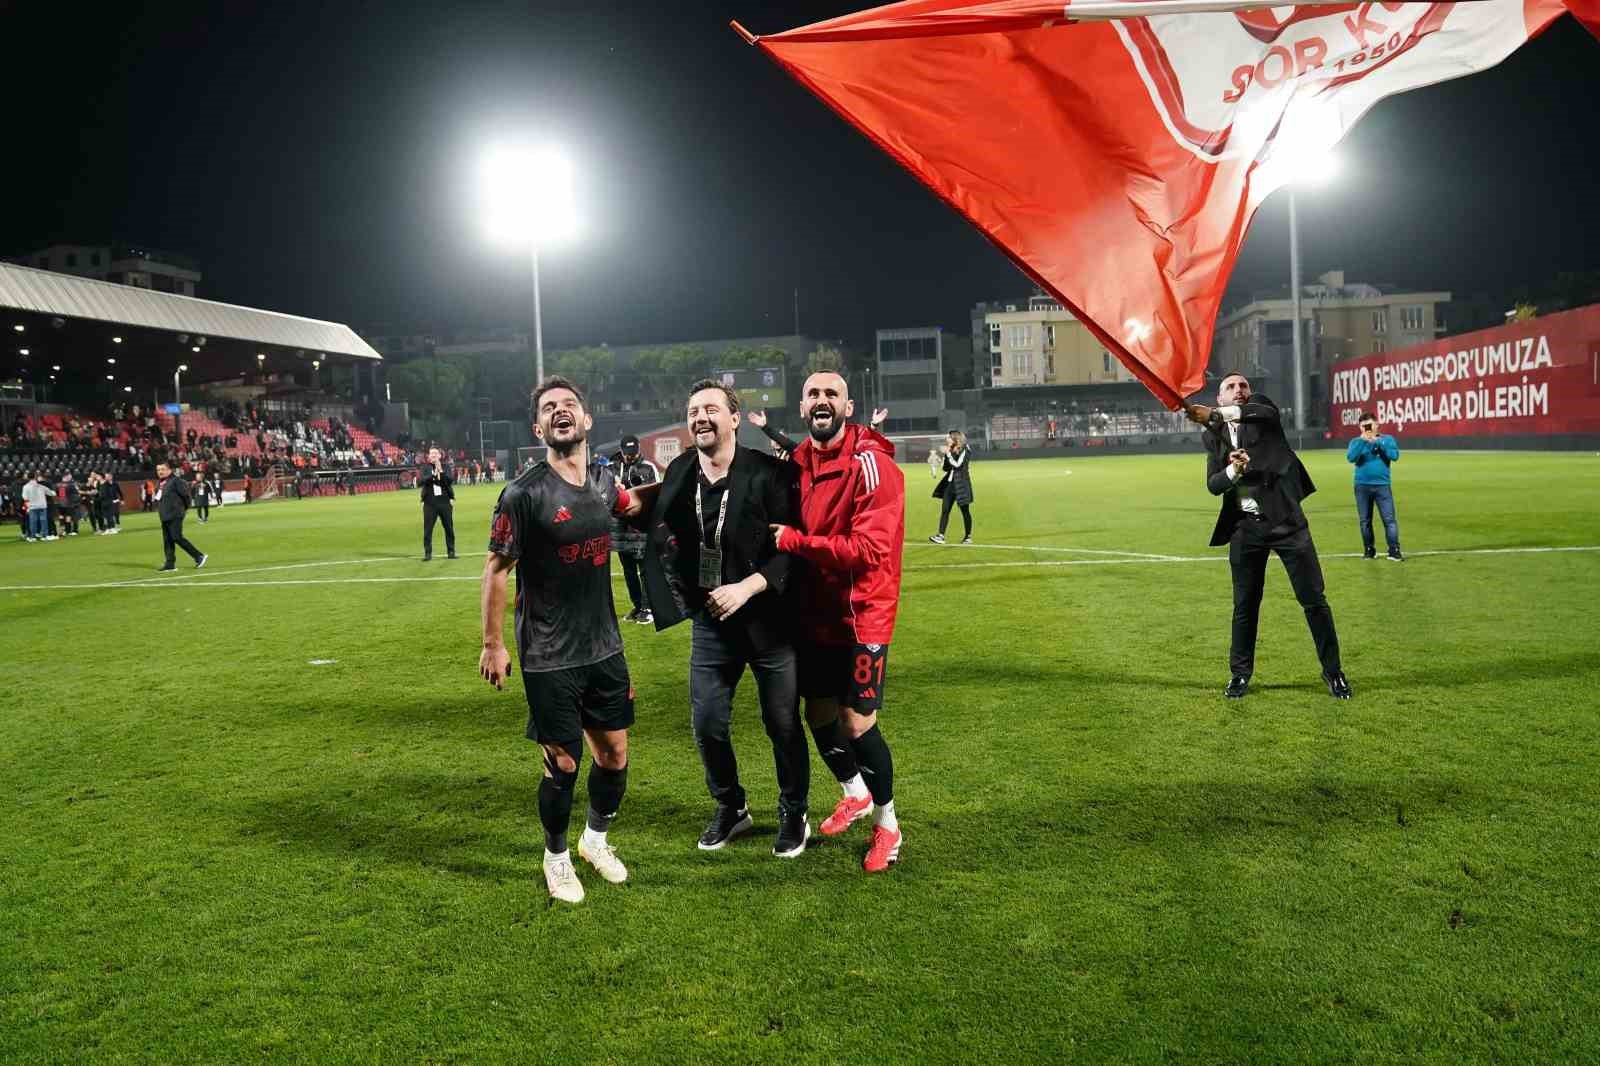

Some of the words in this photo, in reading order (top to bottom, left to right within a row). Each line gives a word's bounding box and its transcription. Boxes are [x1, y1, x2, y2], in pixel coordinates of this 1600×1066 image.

[1334, 32, 1401, 72] 1950
[1333, 366, 1371, 404] ATKO
[1342, 408, 1361, 425] GRUP
[1377, 391, 1461, 432] BAŞARILAR
[1466, 376, 1549, 419] DİLERİM
[854, 653, 884, 685] 81
